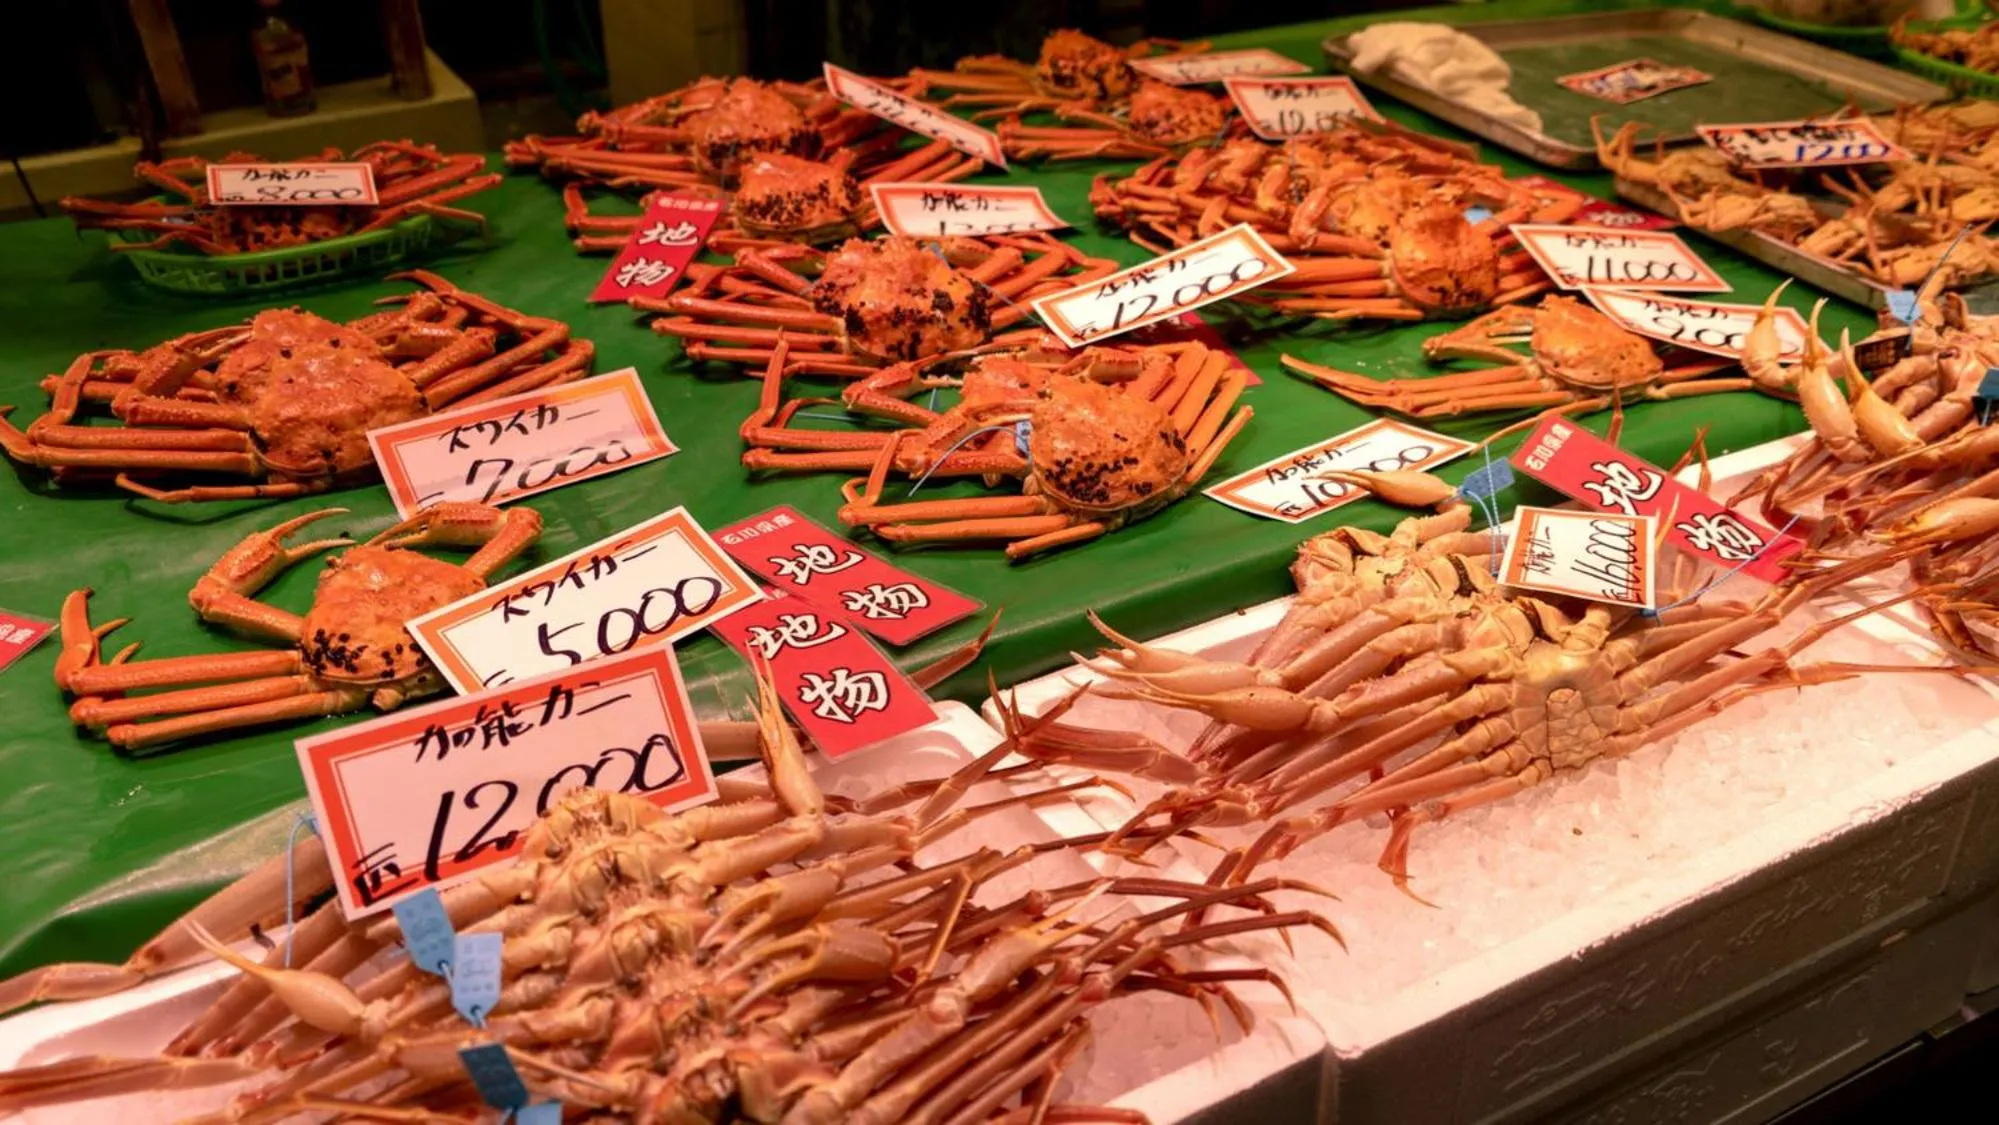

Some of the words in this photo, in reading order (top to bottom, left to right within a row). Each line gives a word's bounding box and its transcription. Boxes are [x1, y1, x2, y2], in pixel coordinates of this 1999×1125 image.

[614, 220, 698, 288] 地物
[768, 543, 931, 620] 地物
[747, 612, 891, 724] 地物
